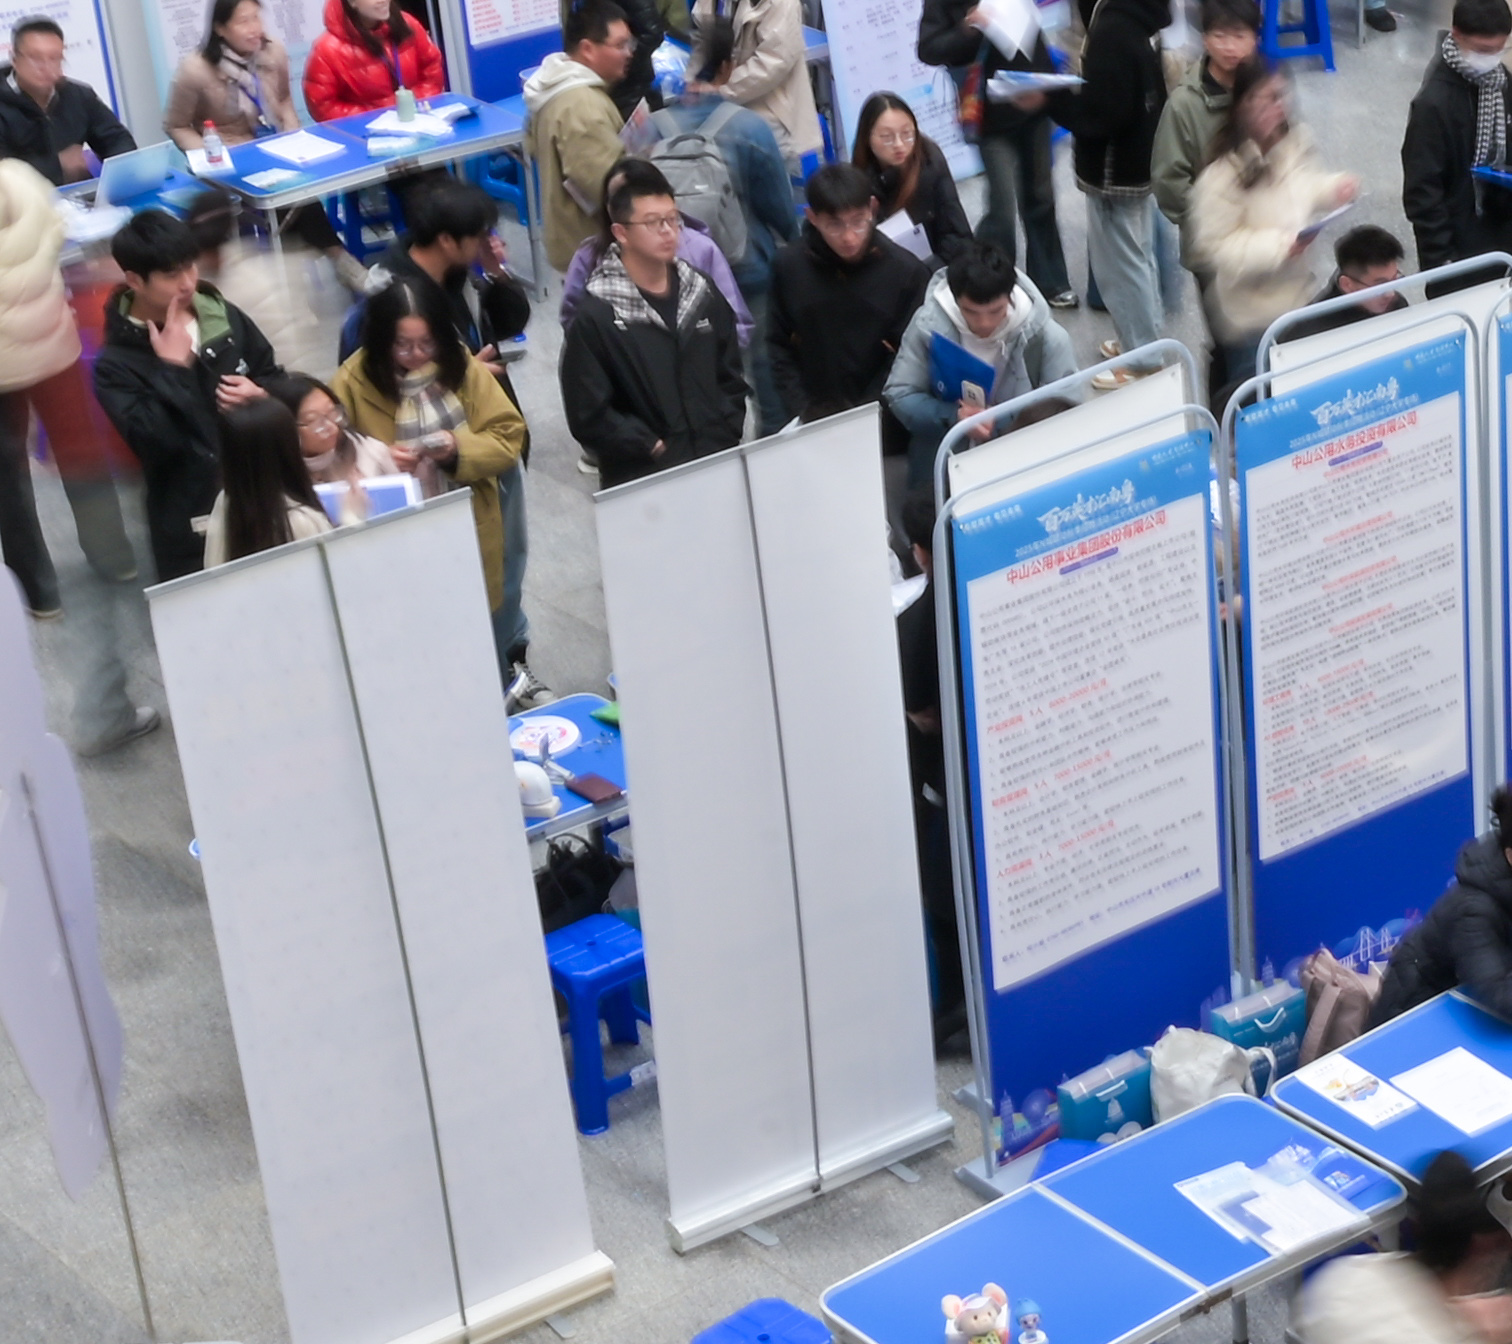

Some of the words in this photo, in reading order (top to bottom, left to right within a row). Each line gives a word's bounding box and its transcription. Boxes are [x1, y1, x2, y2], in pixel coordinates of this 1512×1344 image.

[1290, 410, 1419, 470] 中山公用水务投资有限公司
[1005, 509, 1168, 586] 中山公用事业集团股份有限公司
